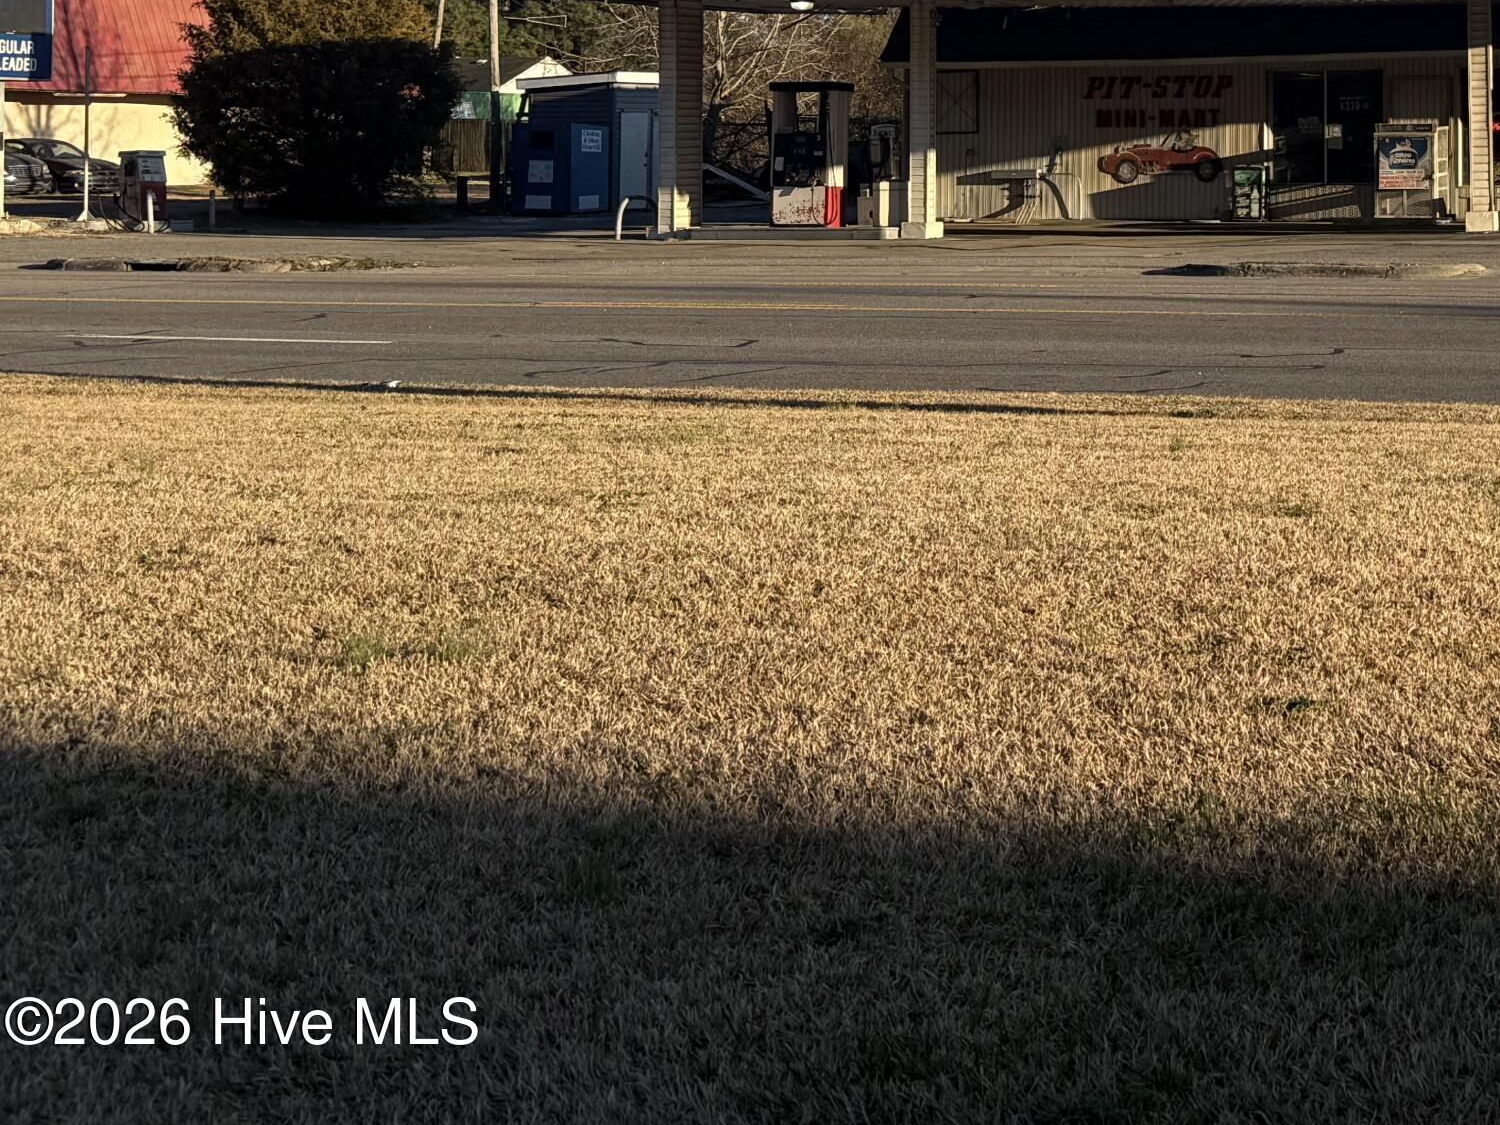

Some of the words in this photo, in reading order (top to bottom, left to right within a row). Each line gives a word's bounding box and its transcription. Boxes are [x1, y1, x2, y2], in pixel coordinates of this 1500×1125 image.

[0, 56, 38, 72] EADED
[1084, 75, 1233, 99] PIT-STOP
[1096, 109, 1220, 128] MINI-MART
